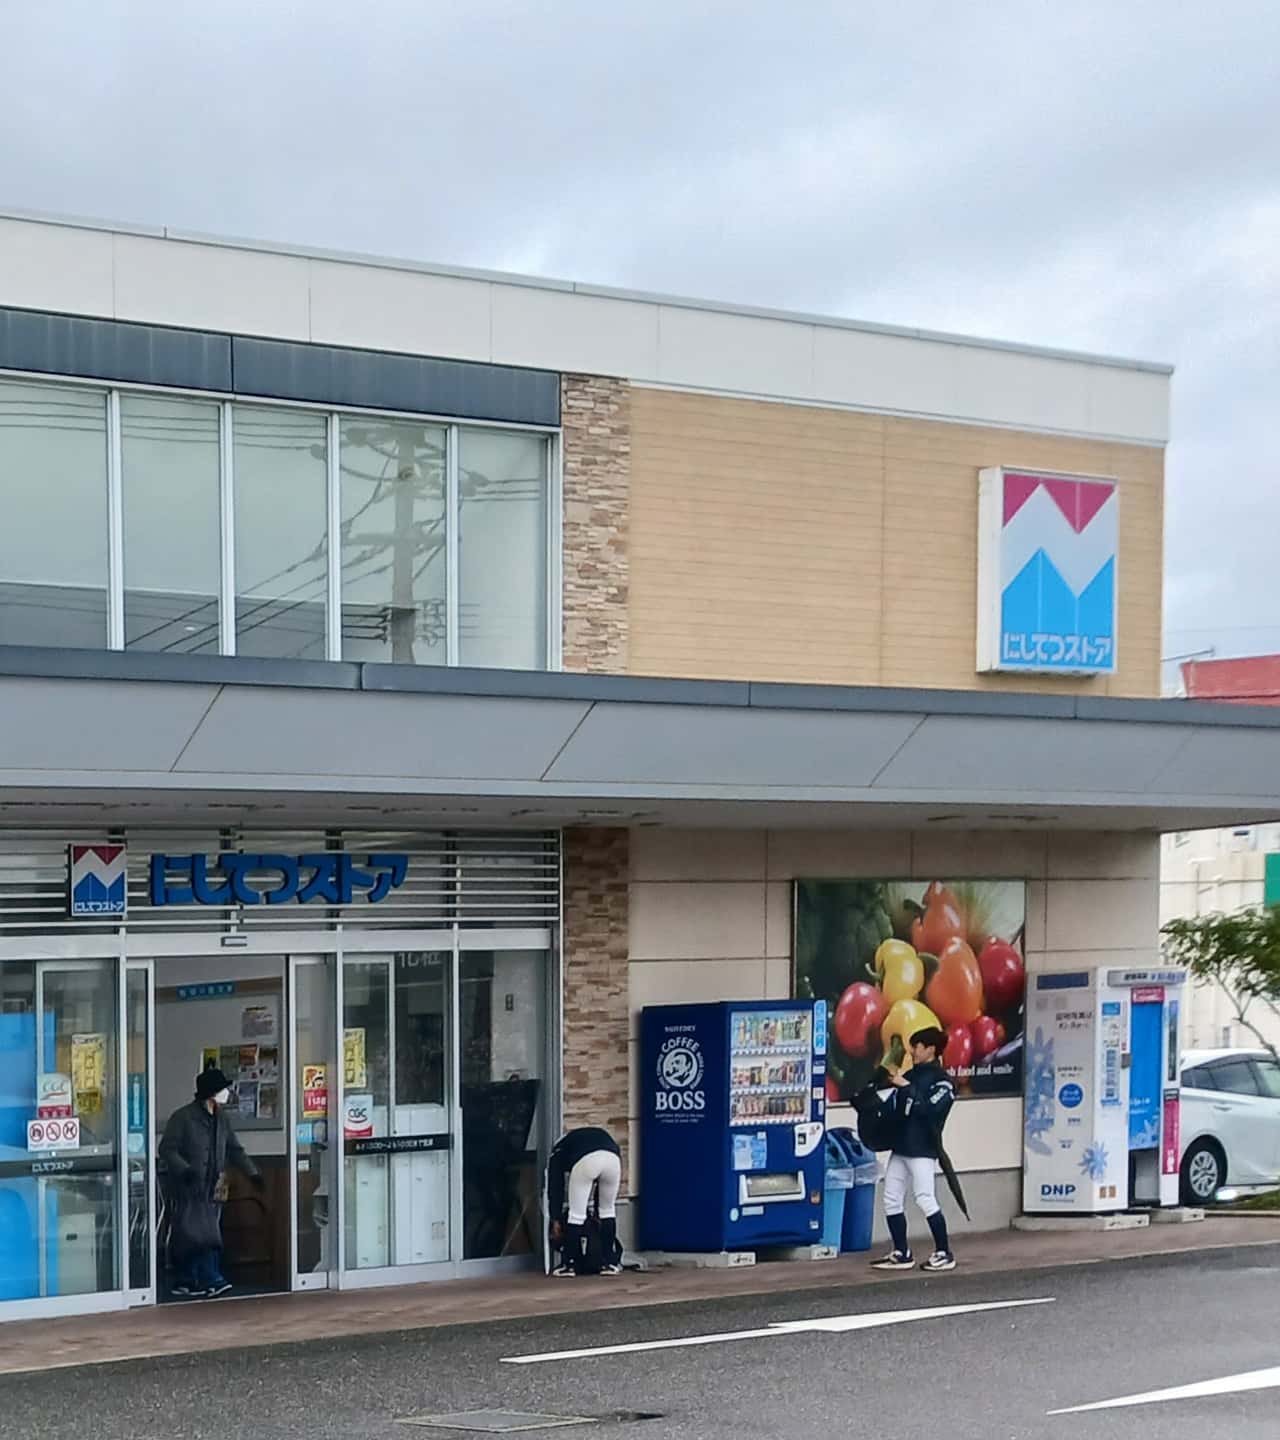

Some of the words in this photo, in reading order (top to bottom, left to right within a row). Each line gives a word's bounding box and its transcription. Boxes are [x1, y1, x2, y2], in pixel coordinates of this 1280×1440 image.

[1003, 633, 1111, 664] にしてつストア
[149, 853, 409, 906] にしてつストア
[74, 901, 124, 913] にしてつストア
[661, 1037, 700, 1053] COFFEE
[655, 1091, 705, 1110] BOSS
[348, 1108, 367, 1118] CGC
[1041, 1184, 1076, 1196] DNP
